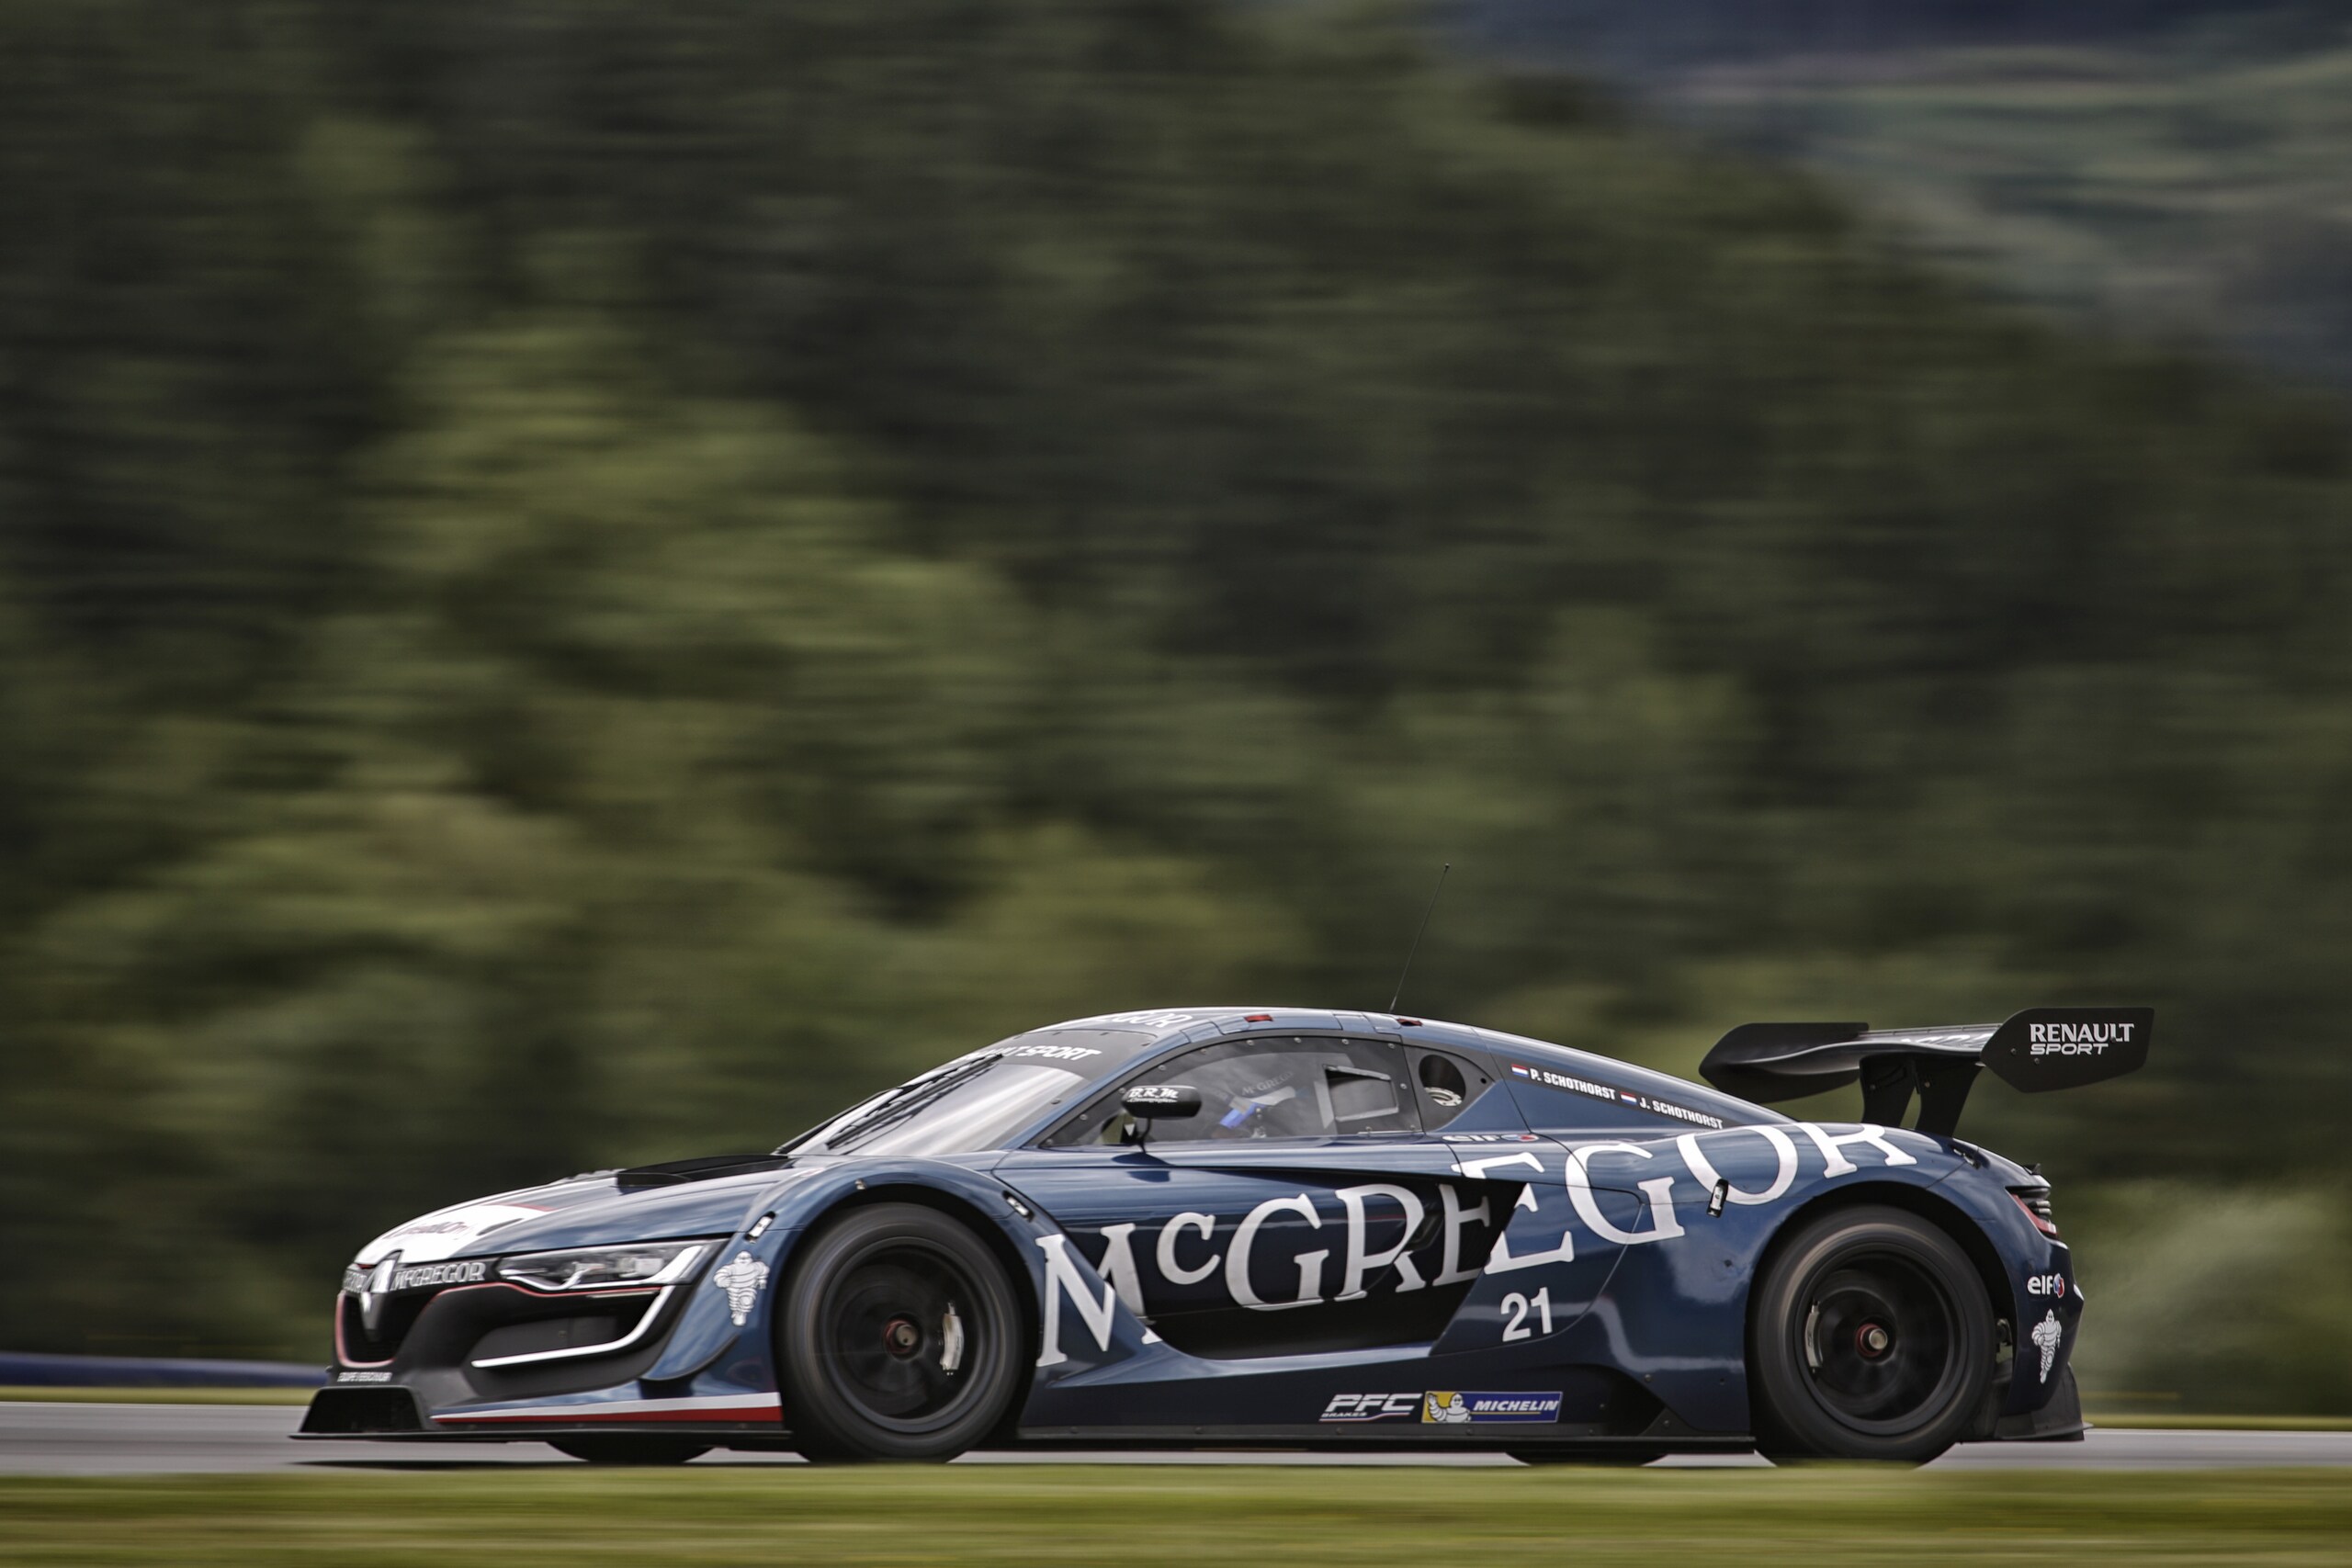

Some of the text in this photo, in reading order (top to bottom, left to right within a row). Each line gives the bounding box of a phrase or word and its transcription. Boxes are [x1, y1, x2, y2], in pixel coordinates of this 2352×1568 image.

[2030, 1023, 2135, 1043] RENAULT
[1015, 1045, 1102, 1061] SPORT
[2030, 1043, 2109, 1055] SPORT
[1529, 1067, 1724, 1130] P. SCHOTHORST J. SCHOTHORST
[1035, 1122, 1918, 1368] McGREGOR
[2027, 1274, 2053, 1295] elf
[1500, 1286, 1553, 1342] 21
[1324, 1393, 1423, 1413] PFC
[1472, 1400, 1560, 1412] MICHELIN
